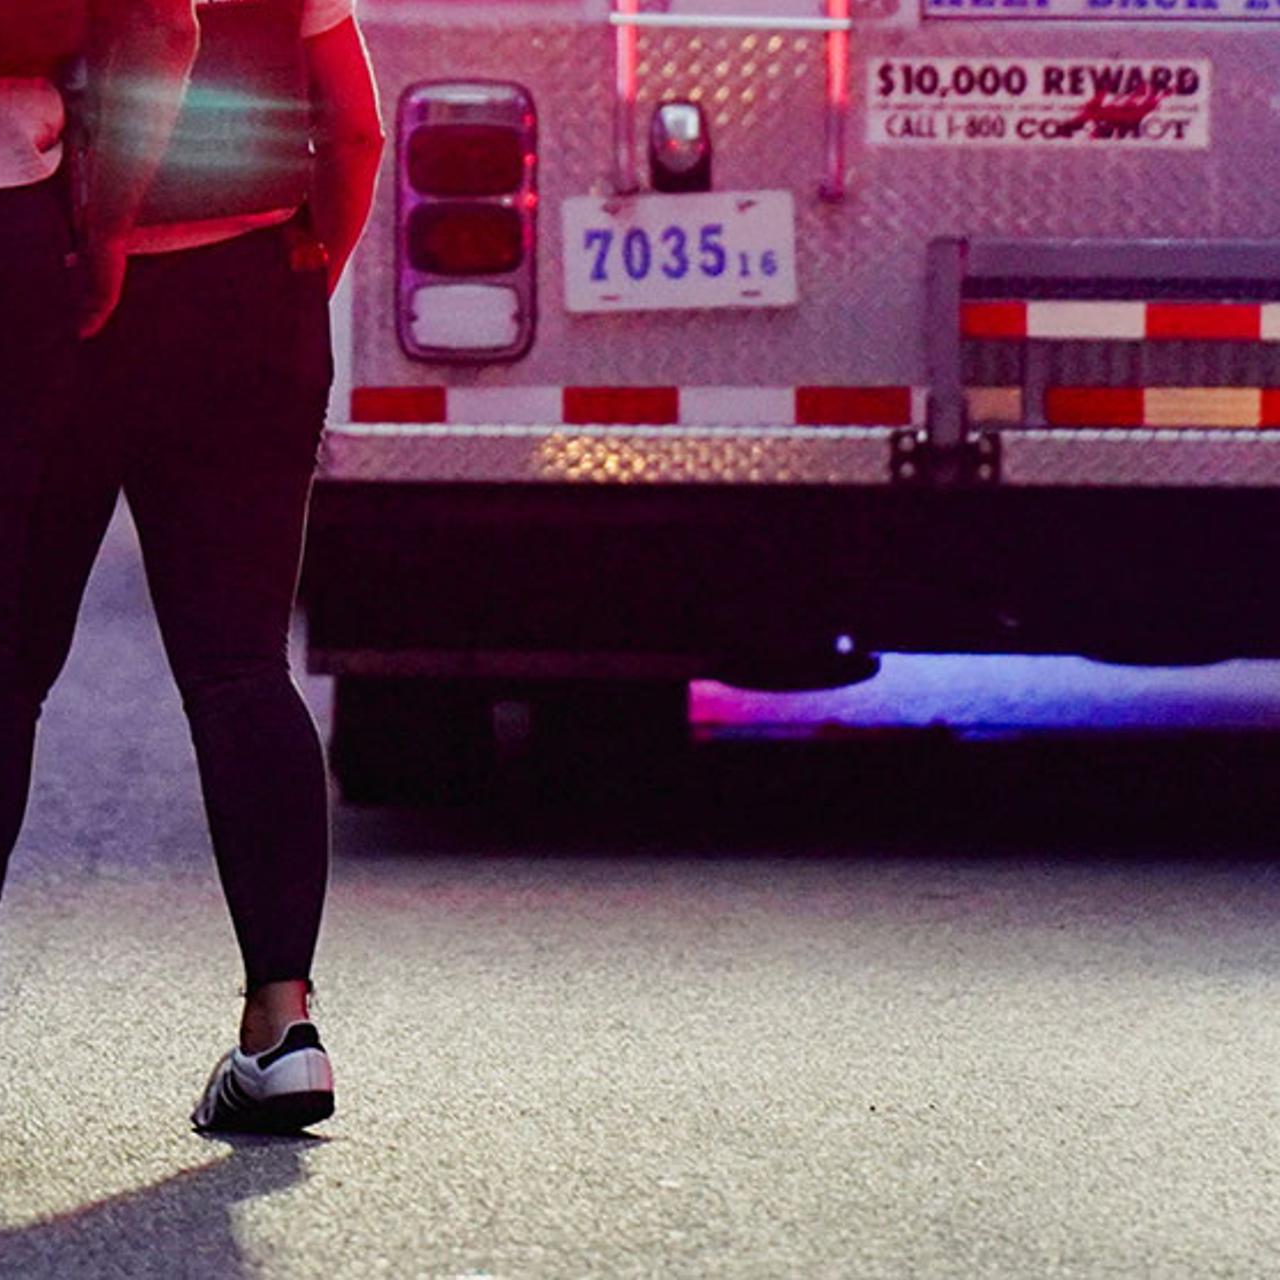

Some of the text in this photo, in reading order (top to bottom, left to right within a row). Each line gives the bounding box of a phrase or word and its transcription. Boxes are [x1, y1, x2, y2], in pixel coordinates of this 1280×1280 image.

[877, 62, 1200, 98] $10,000 REWARD
[884, 115, 936, 139] CALL
[948, 115, 1006, 138] 1-800
[584, 224, 778, 282] 7035 16
